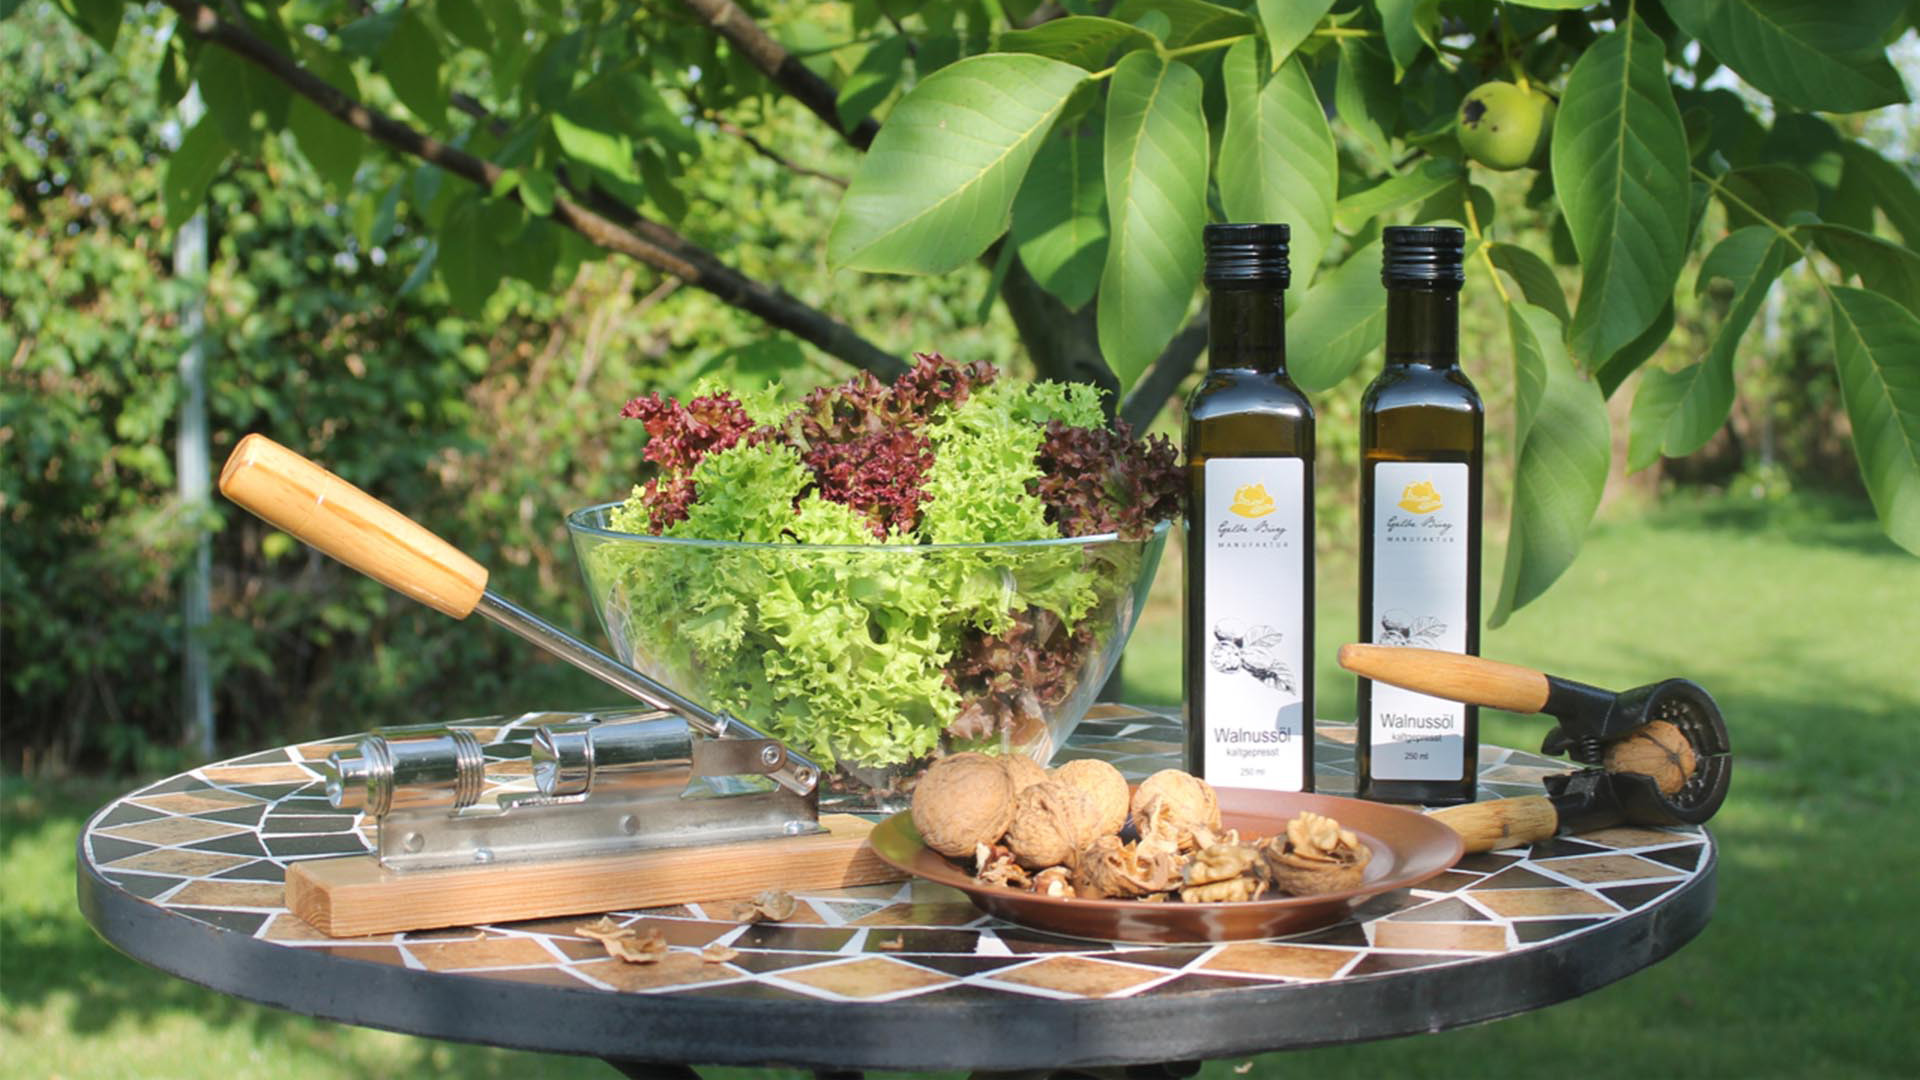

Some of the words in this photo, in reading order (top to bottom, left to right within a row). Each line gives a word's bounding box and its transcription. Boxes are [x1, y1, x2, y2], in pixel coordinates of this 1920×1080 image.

[1380, 713, 1454, 729] Walnussöl
[1214, 726, 1291, 743] Walnussöl
[1226, 748, 1280, 758] kaltgepresst
[1404, 752, 1418, 761] 250
[1419, 752, 1429, 761] ml
[1240, 768, 1253, 777] 250
